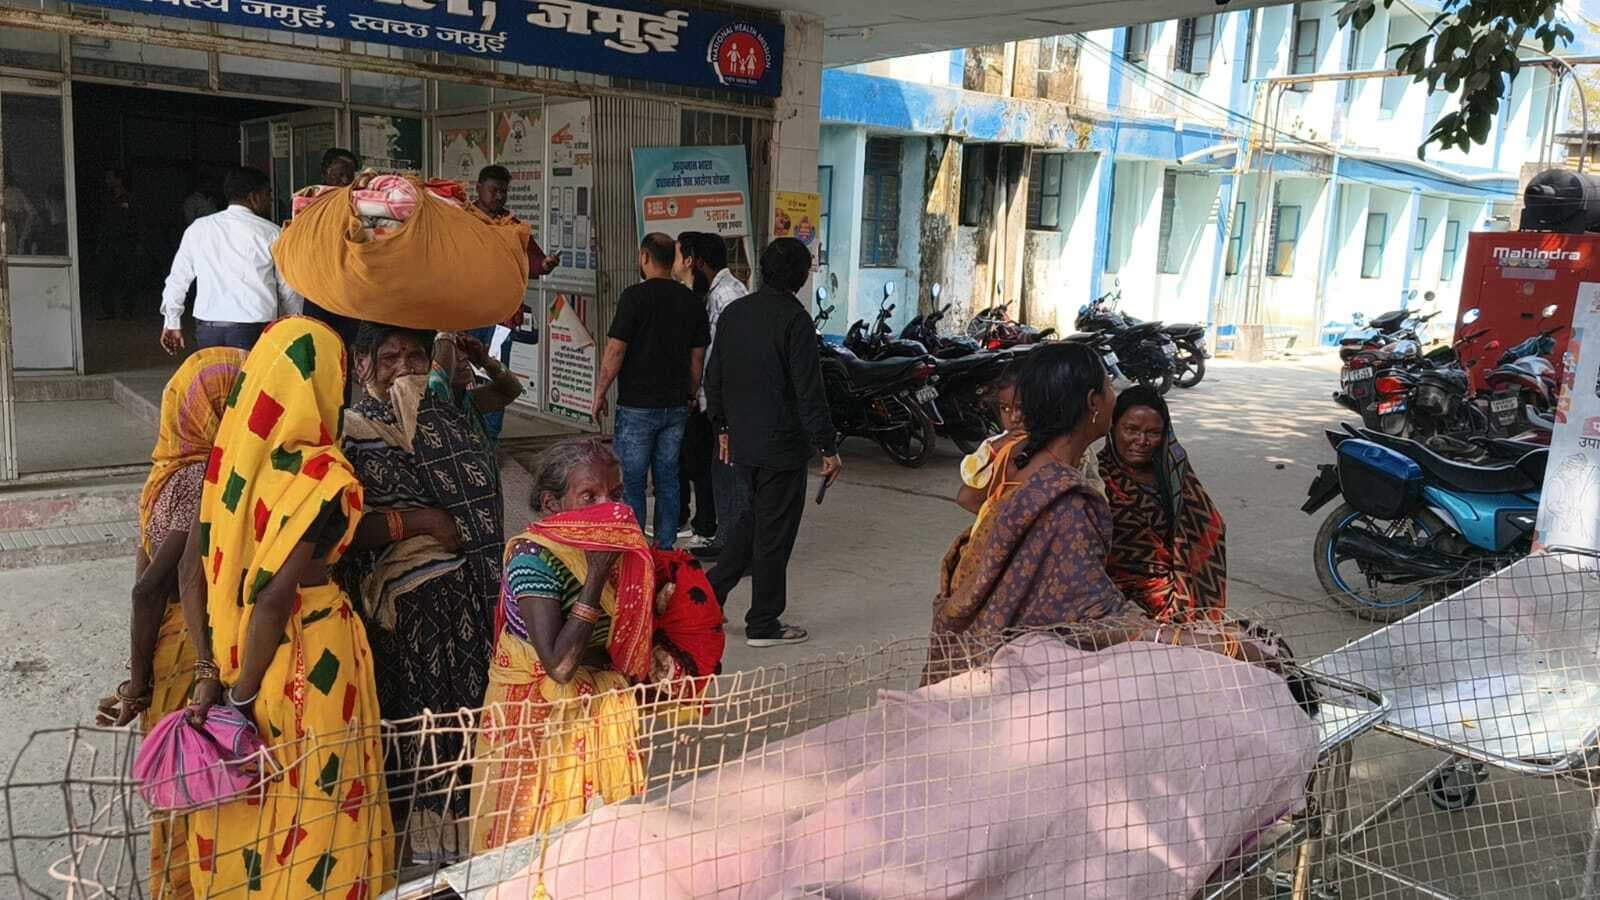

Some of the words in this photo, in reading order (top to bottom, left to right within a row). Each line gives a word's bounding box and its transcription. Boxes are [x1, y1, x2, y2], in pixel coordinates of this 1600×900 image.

[240, 0, 336, 29] जमुई,
[349, 14, 430, 39] स्वच्छ
[435, 26, 508, 53] जमुई
[526, 0, 689, 53] जमुई
[712, 27, 733, 61] NATIONAL
[734, 23, 758, 36] HEALTH
[757, 33, 772, 69] MISSION
[1493, 247, 1580, 260] Mahindra
